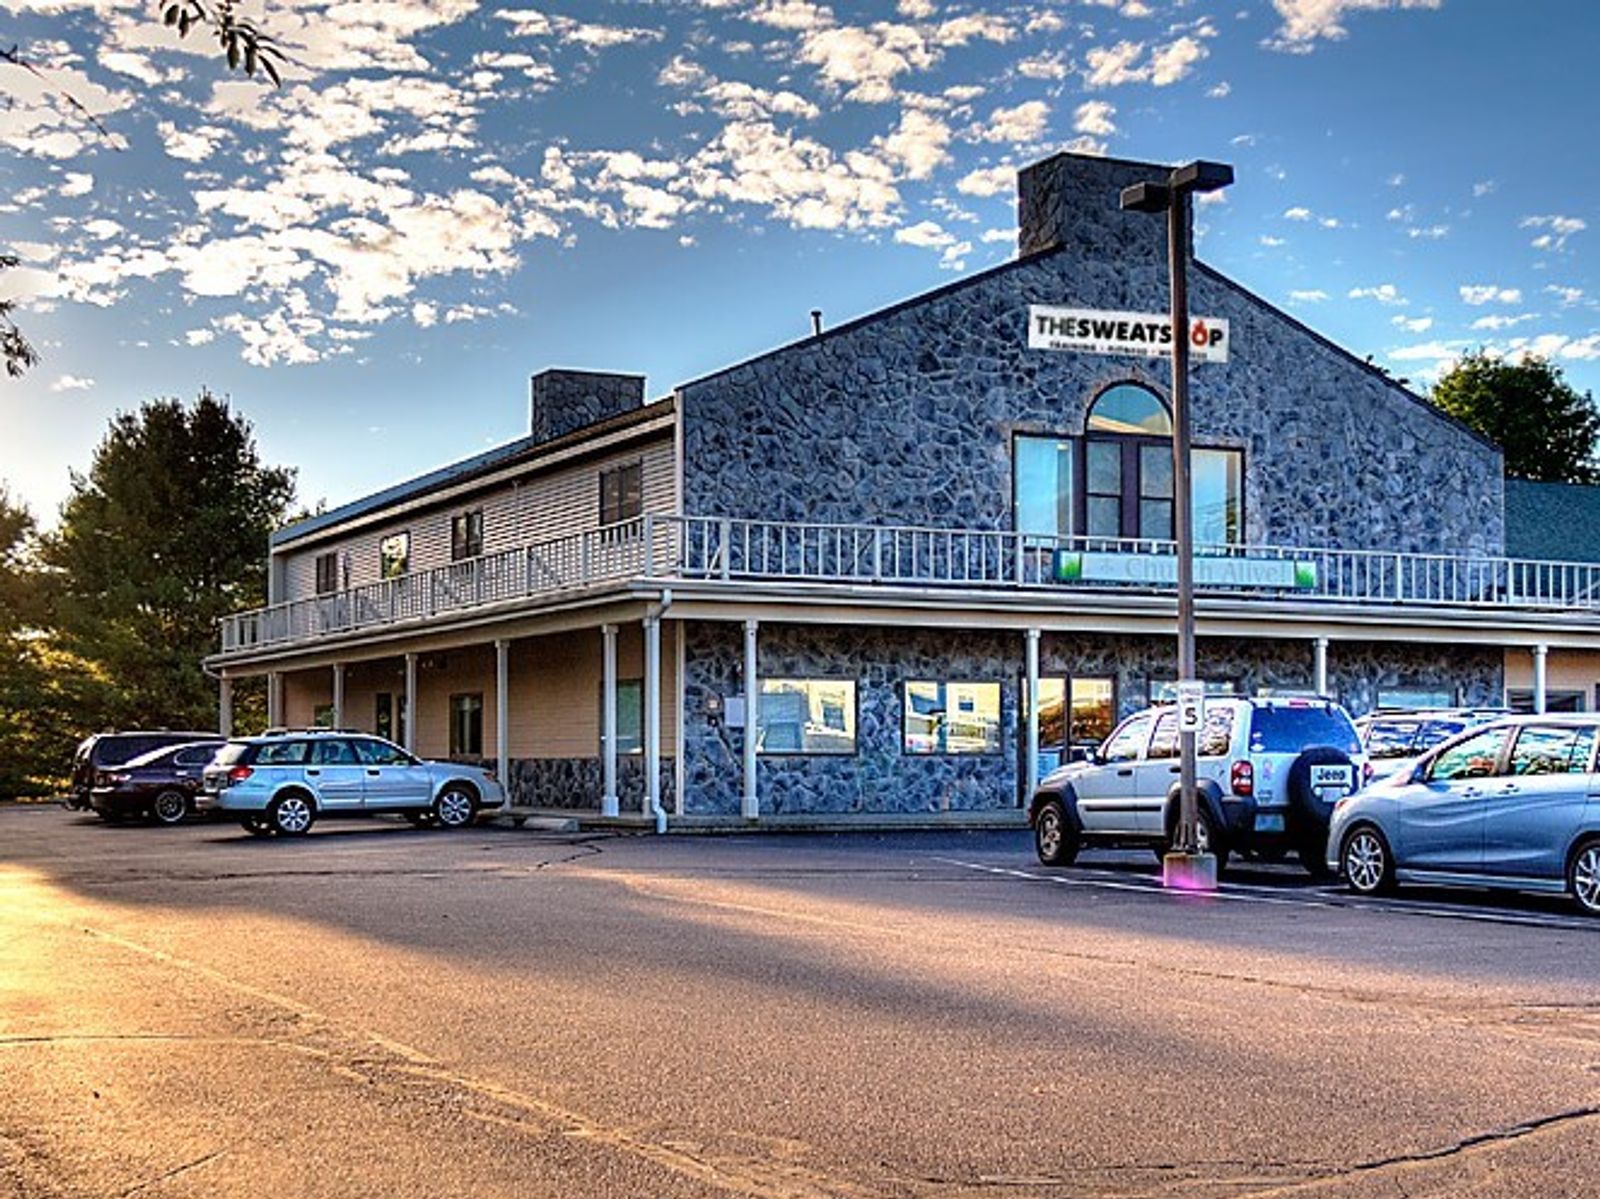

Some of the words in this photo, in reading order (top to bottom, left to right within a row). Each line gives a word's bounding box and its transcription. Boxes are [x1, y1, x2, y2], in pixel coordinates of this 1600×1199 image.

[1035, 315, 1223, 347] THESWEATSOP
[1126, 557, 1212, 582] Chuh
[1316, 768, 1345, 781] Jeep
